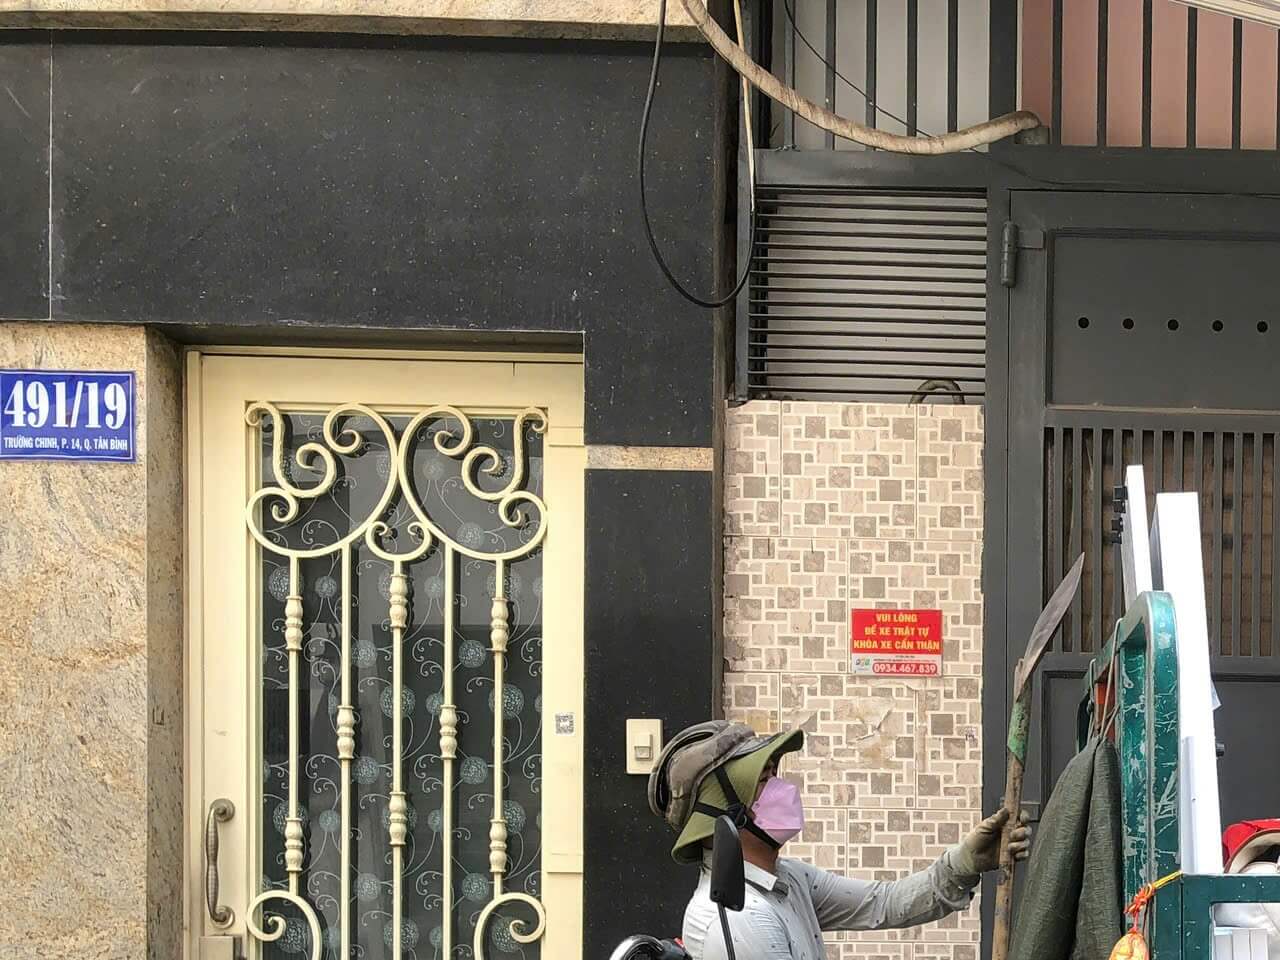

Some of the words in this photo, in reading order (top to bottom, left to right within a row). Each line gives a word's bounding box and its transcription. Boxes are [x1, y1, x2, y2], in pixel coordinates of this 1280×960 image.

[4, 380, 127, 430] 491/19
[61, 438, 70, 449] P.
[84, 438, 92, 451] Q.
[94, 436, 109, 450] TÂN
[110, 436, 128, 451] BÌNH
[875, 613, 891, 623] VUI
[880, 627, 891, 636] XE
[881, 640, 893, 649] XE
[873, 664, 936, 674] 0934.467.839
